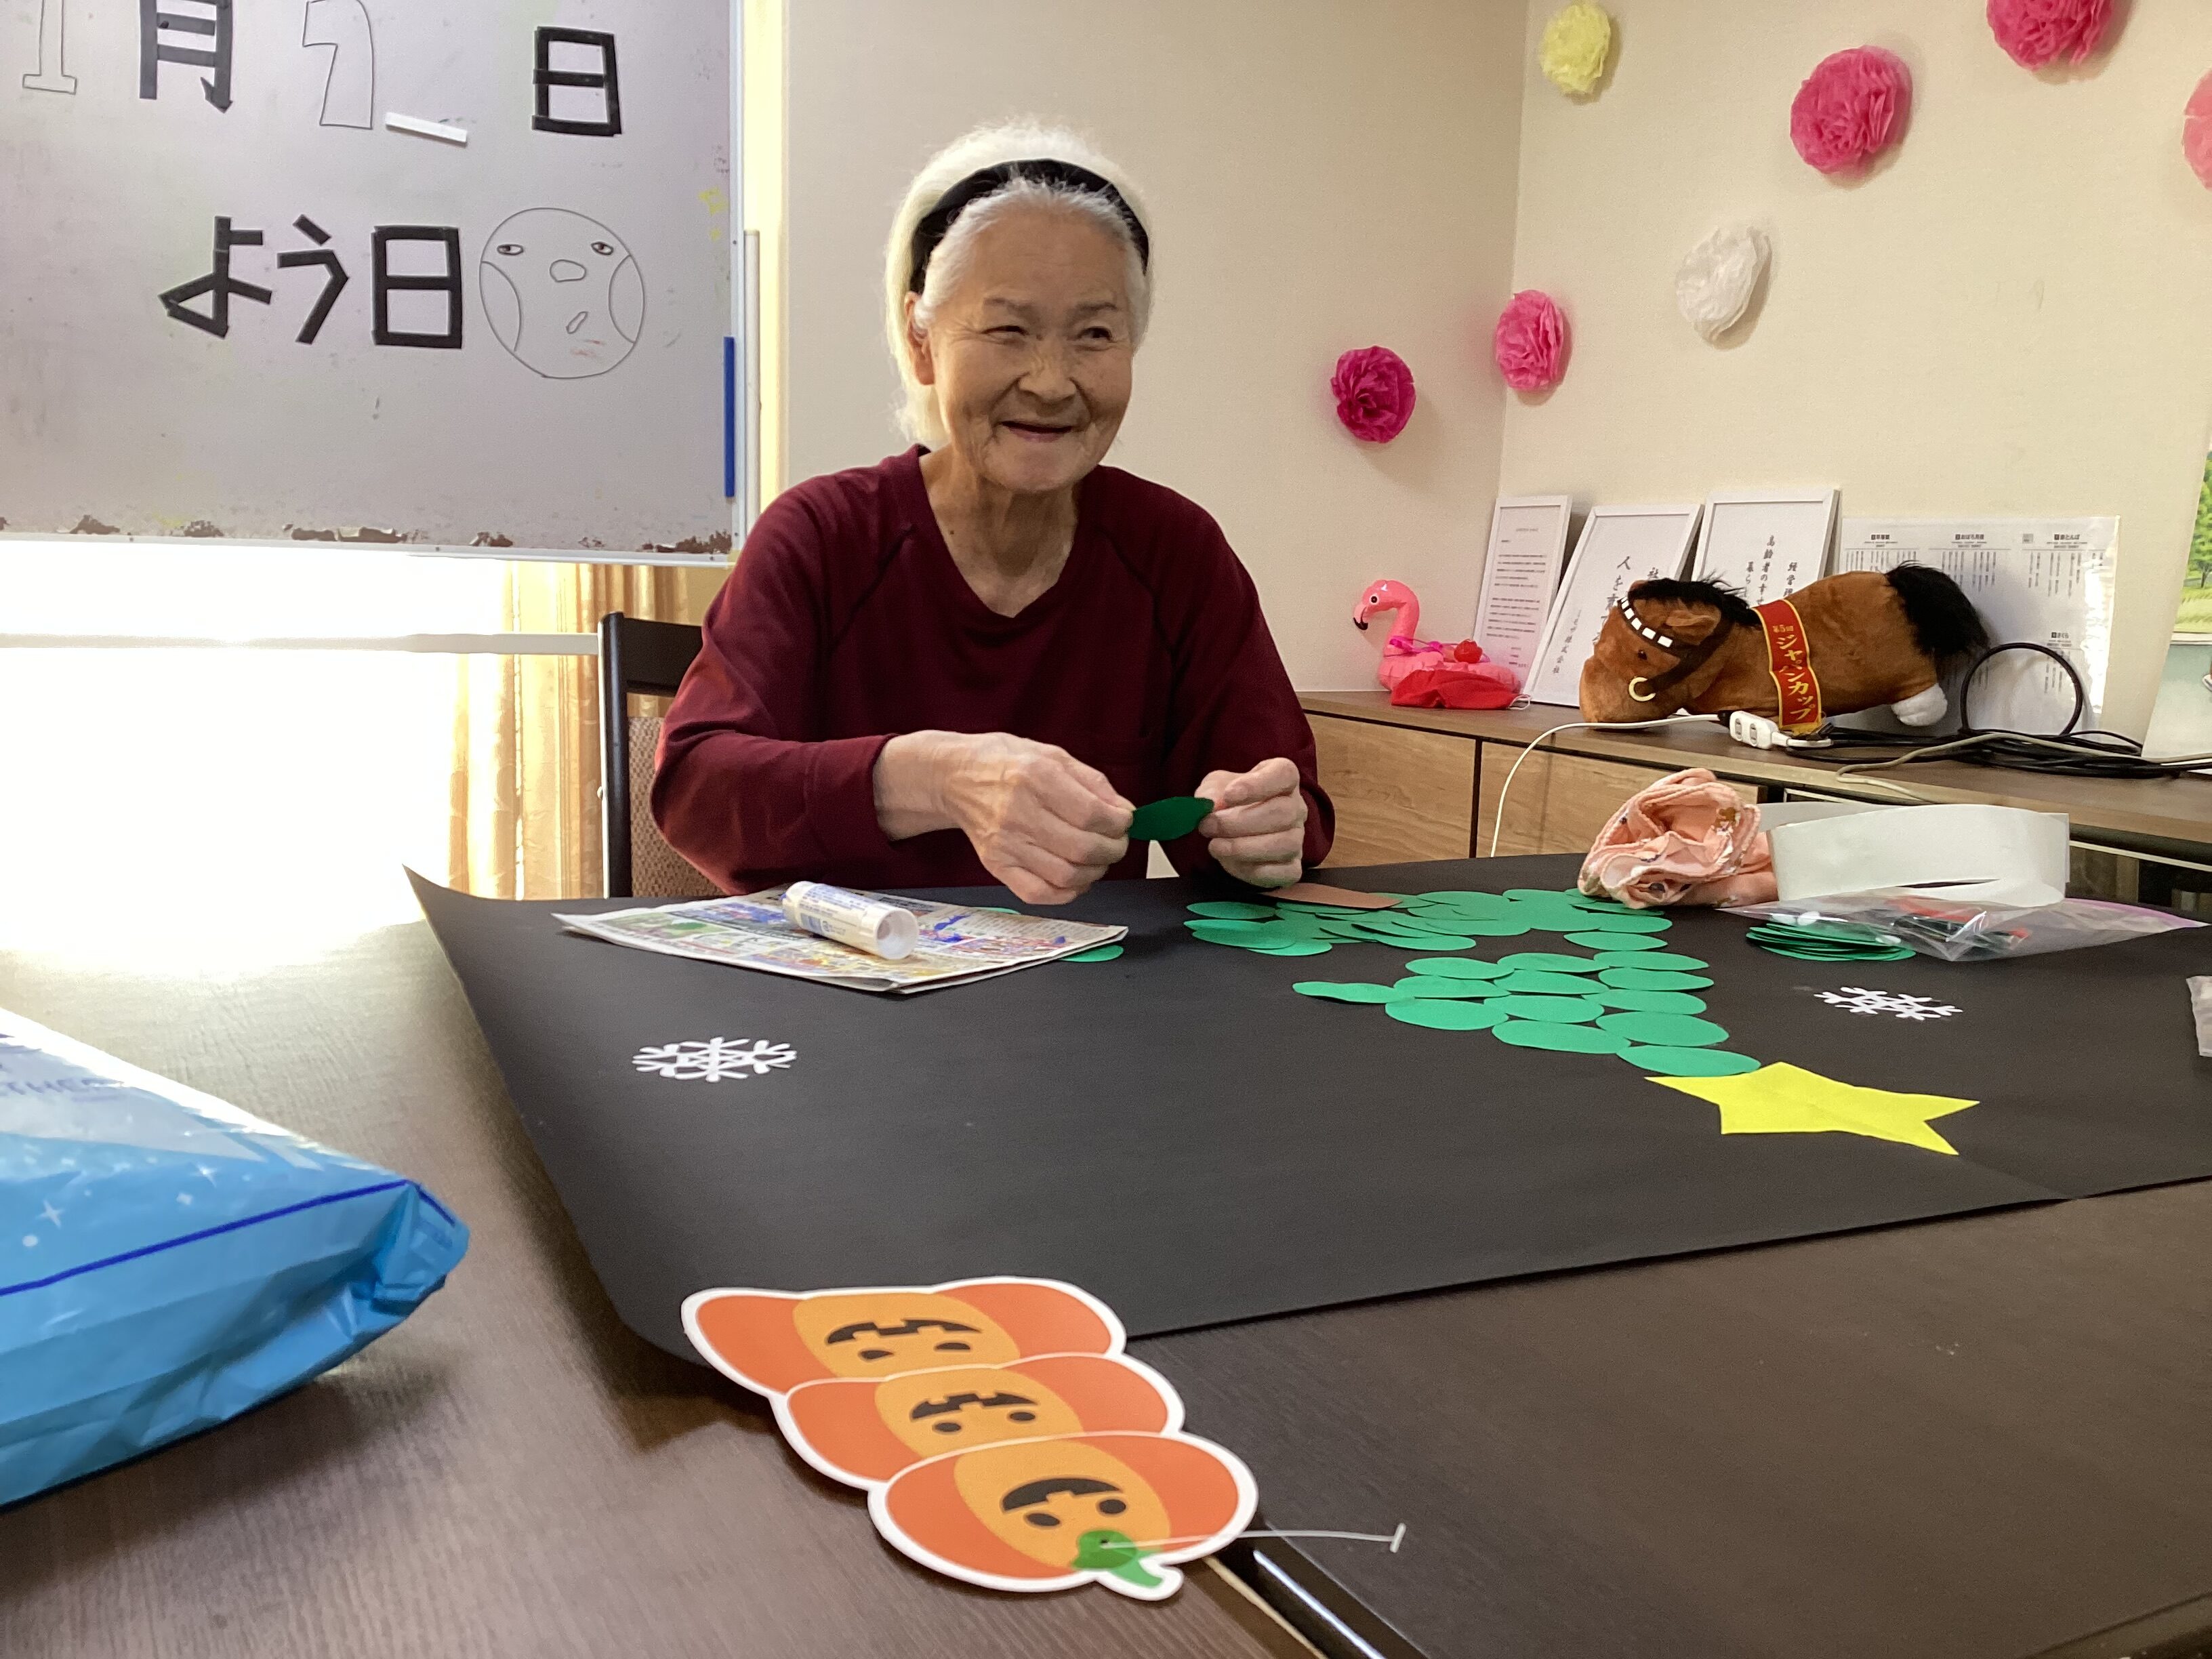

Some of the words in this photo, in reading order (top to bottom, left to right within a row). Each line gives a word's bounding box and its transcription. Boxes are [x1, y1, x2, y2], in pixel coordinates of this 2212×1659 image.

[158, 214, 462, 350] よう日
[1776, 634, 1816, 721] ジャパンカップ
